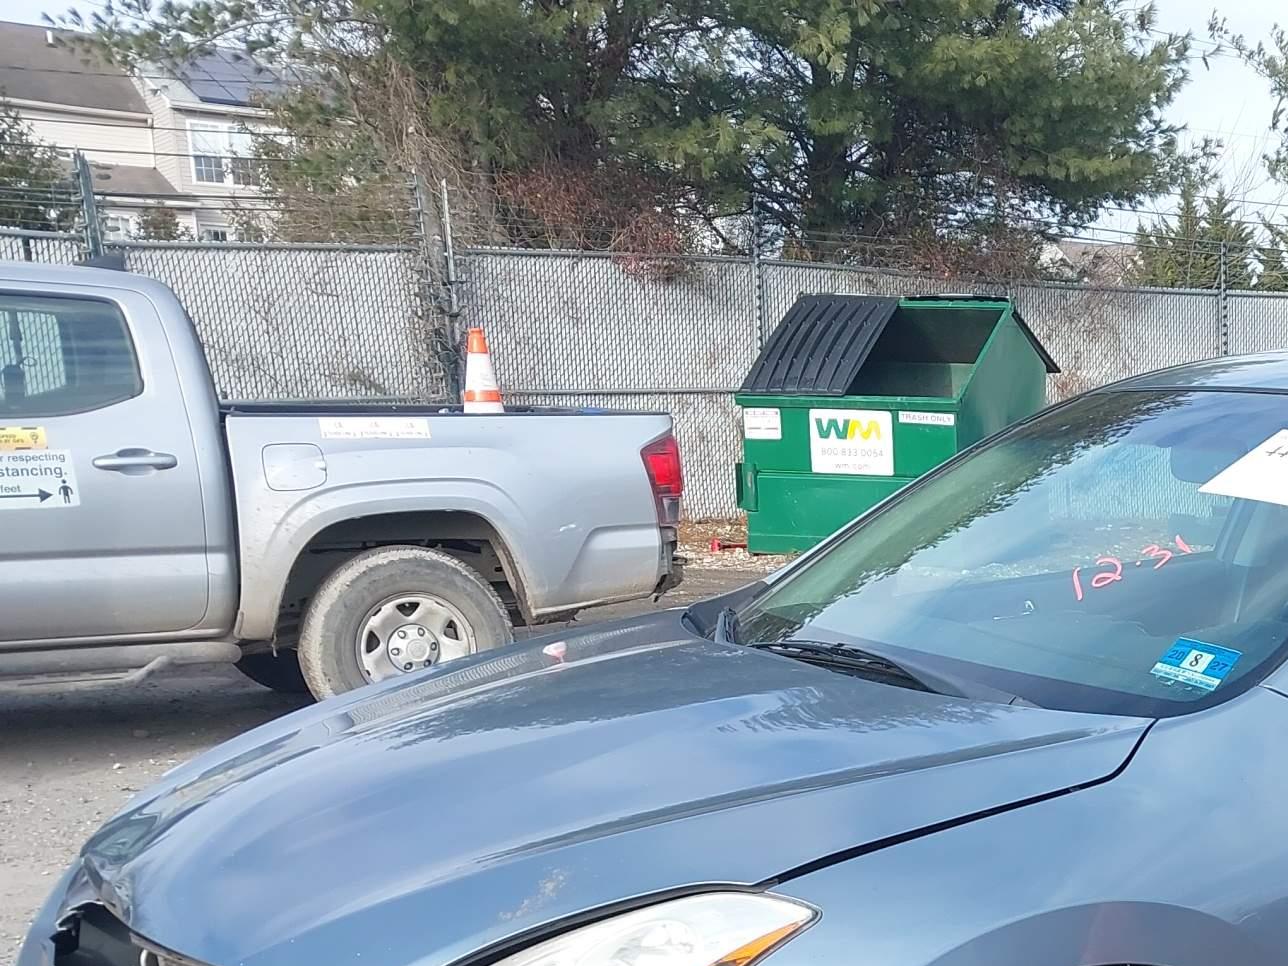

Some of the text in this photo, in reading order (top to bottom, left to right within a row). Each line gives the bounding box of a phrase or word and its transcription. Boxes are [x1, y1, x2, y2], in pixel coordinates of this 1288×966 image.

[901, 413, 952, 423] TRASH ONLY
[815, 417, 882, 440] WM
[7, 453, 66, 464] respecting
[1189, 653, 1204, 668] 8
[1209, 661, 1229, 672] 27
